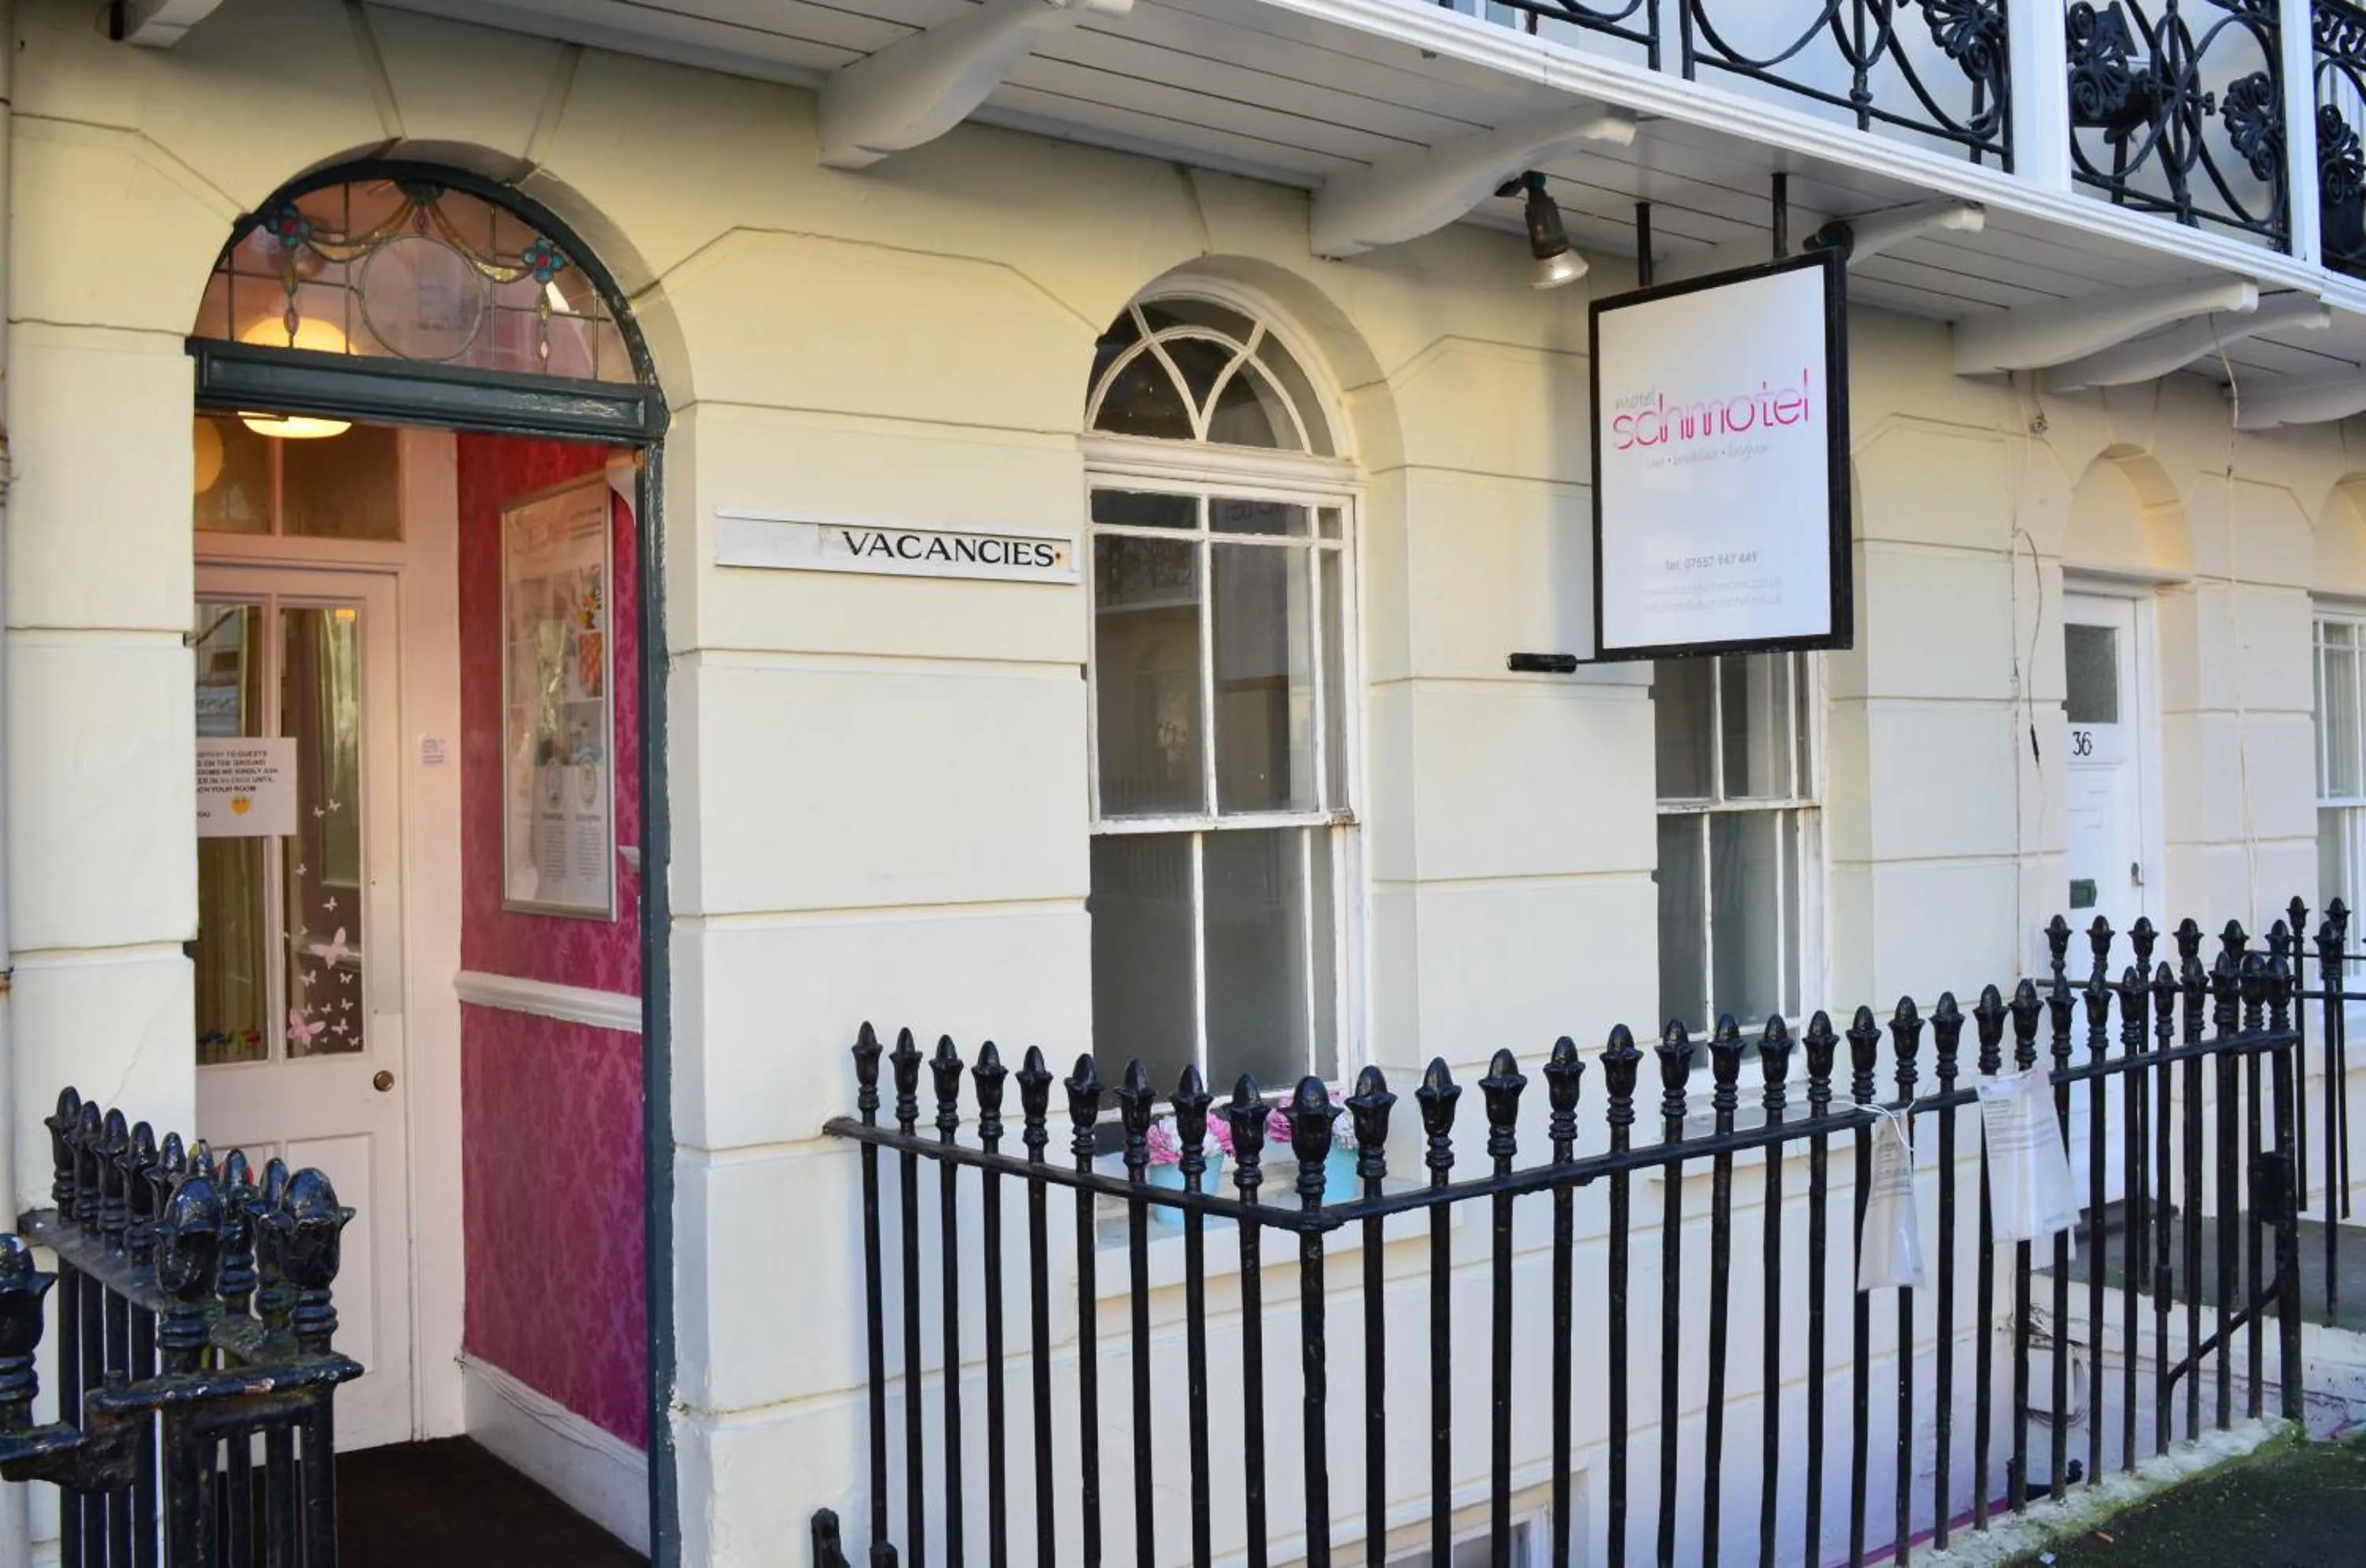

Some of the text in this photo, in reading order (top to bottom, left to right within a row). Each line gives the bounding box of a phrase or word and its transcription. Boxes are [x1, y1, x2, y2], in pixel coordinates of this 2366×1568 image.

[1613, 368, 1808, 450] schmotel
[842, 531, 1055, 567] VACANCIES
[2072, 731, 2092, 756] 36
